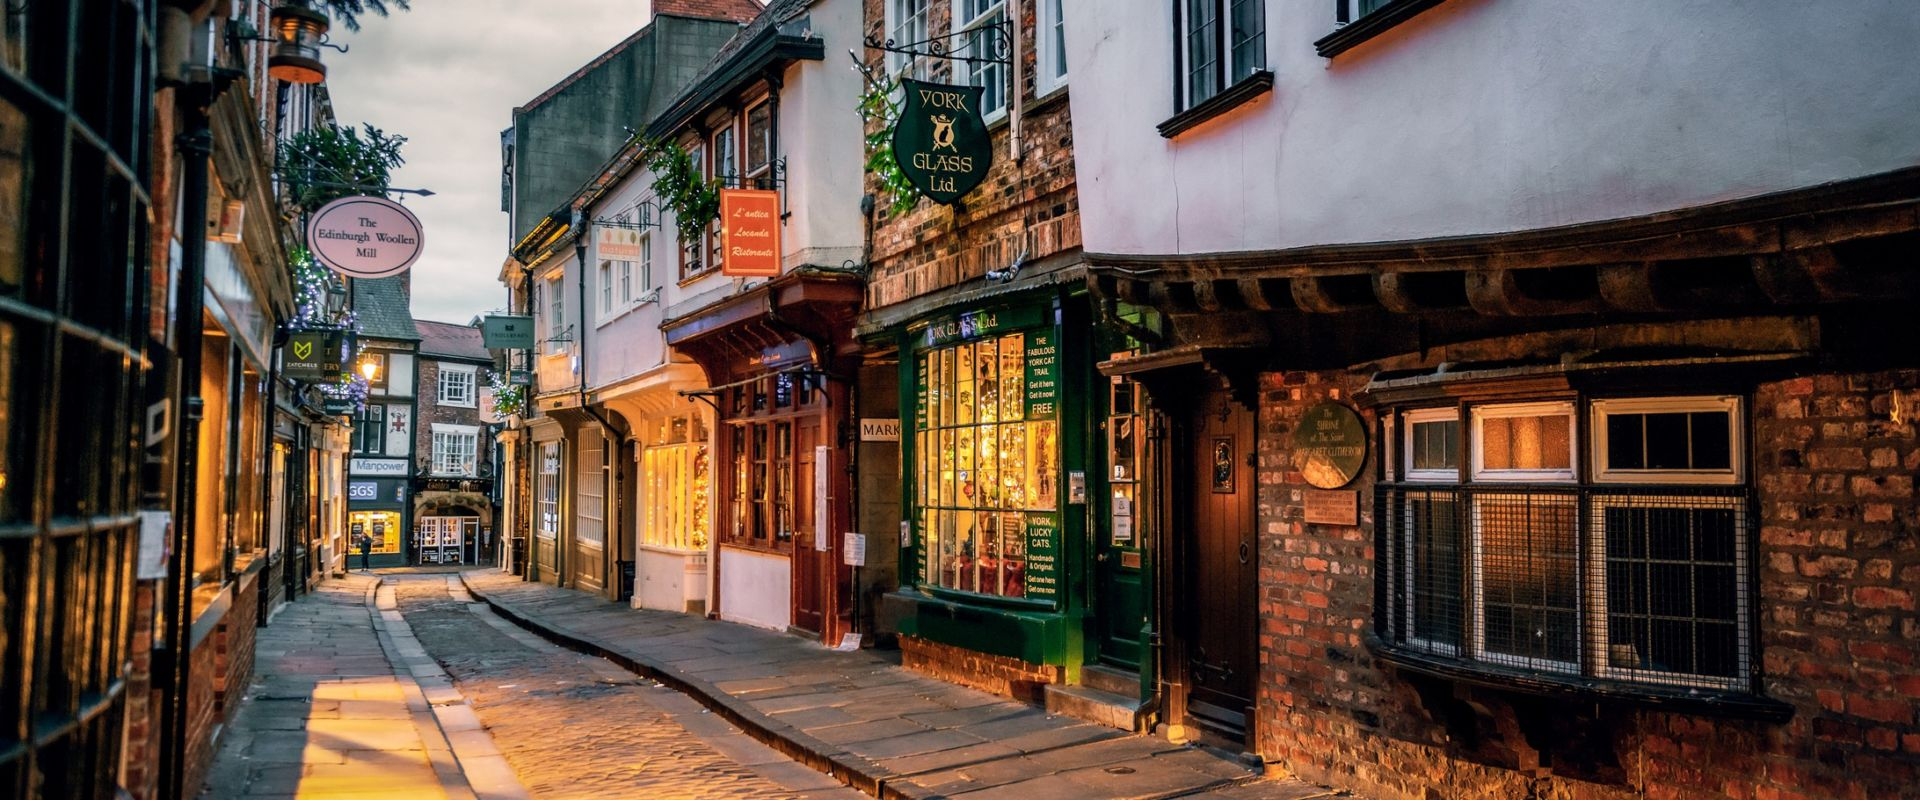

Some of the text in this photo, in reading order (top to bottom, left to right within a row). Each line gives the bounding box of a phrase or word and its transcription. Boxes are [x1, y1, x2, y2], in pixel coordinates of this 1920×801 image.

[919, 89, 970, 113] YORK
[913, 152, 972, 173] GLASS
[930, 176, 957, 193] Ltd.
[358, 217, 377, 228] The
[318, 229, 415, 245] Edinburgh Woollen
[734, 228, 769, 238] Locanda
[356, 248, 377, 258] Mill
[732, 246, 773, 257] Ristorante
[1036, 337, 1047, 345] THE
[1027, 346, 1056, 356] FABULOUS
[1043, 356, 1055, 365] CAT
[1034, 367, 1049, 376] TRAIL
[1029, 381, 1039, 389] Get
[1043, 380, 1055, 388] here
[1028, 391, 1039, 399] Get
[1043, 389, 1055, 398] now!
[1032, 402, 1053, 414] FREE
[863, 424, 900, 436] MARK
[356, 460, 405, 472] Manpower
[349, 485, 374, 497] GGS
[1032, 517, 1051, 526] YORK
[1029, 528, 1053, 537] LUCKY
[1031, 539, 1052, 549] CATS.
[1029, 554, 1055, 562] Handmade
[1027, 575, 1037, 583] Get
[1045, 576, 1056, 584] here
[1027, 585, 1037, 593] Get
